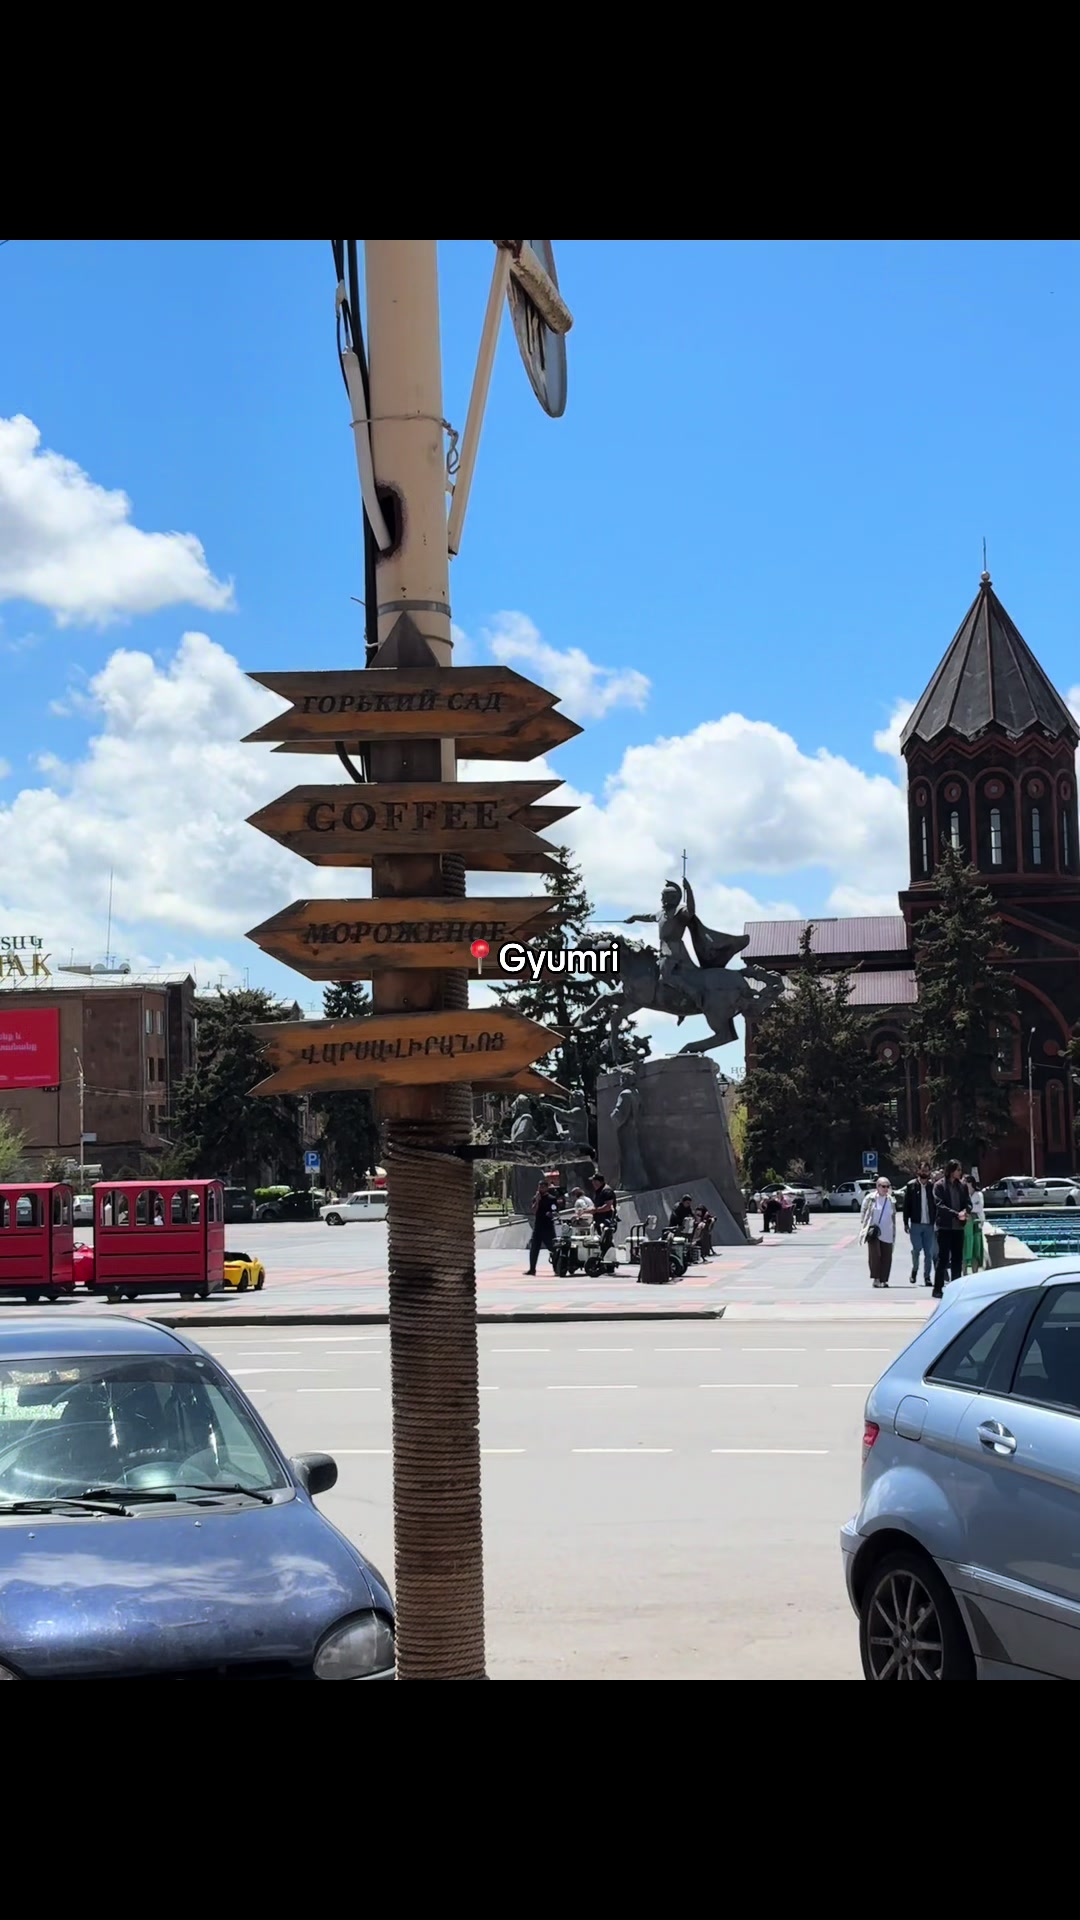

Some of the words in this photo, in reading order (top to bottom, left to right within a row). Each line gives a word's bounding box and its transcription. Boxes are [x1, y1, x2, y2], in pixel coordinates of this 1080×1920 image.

[302, 688, 440, 713] ГОРЬКИЙ
[448, 692, 503, 713] САД
[306, 801, 500, 833] COFFEE
[303, 920, 507, 944] МОРОЖЕНОЕ
[308, 1153, 317, 1166] P
[866, 1153, 876, 1166] P
